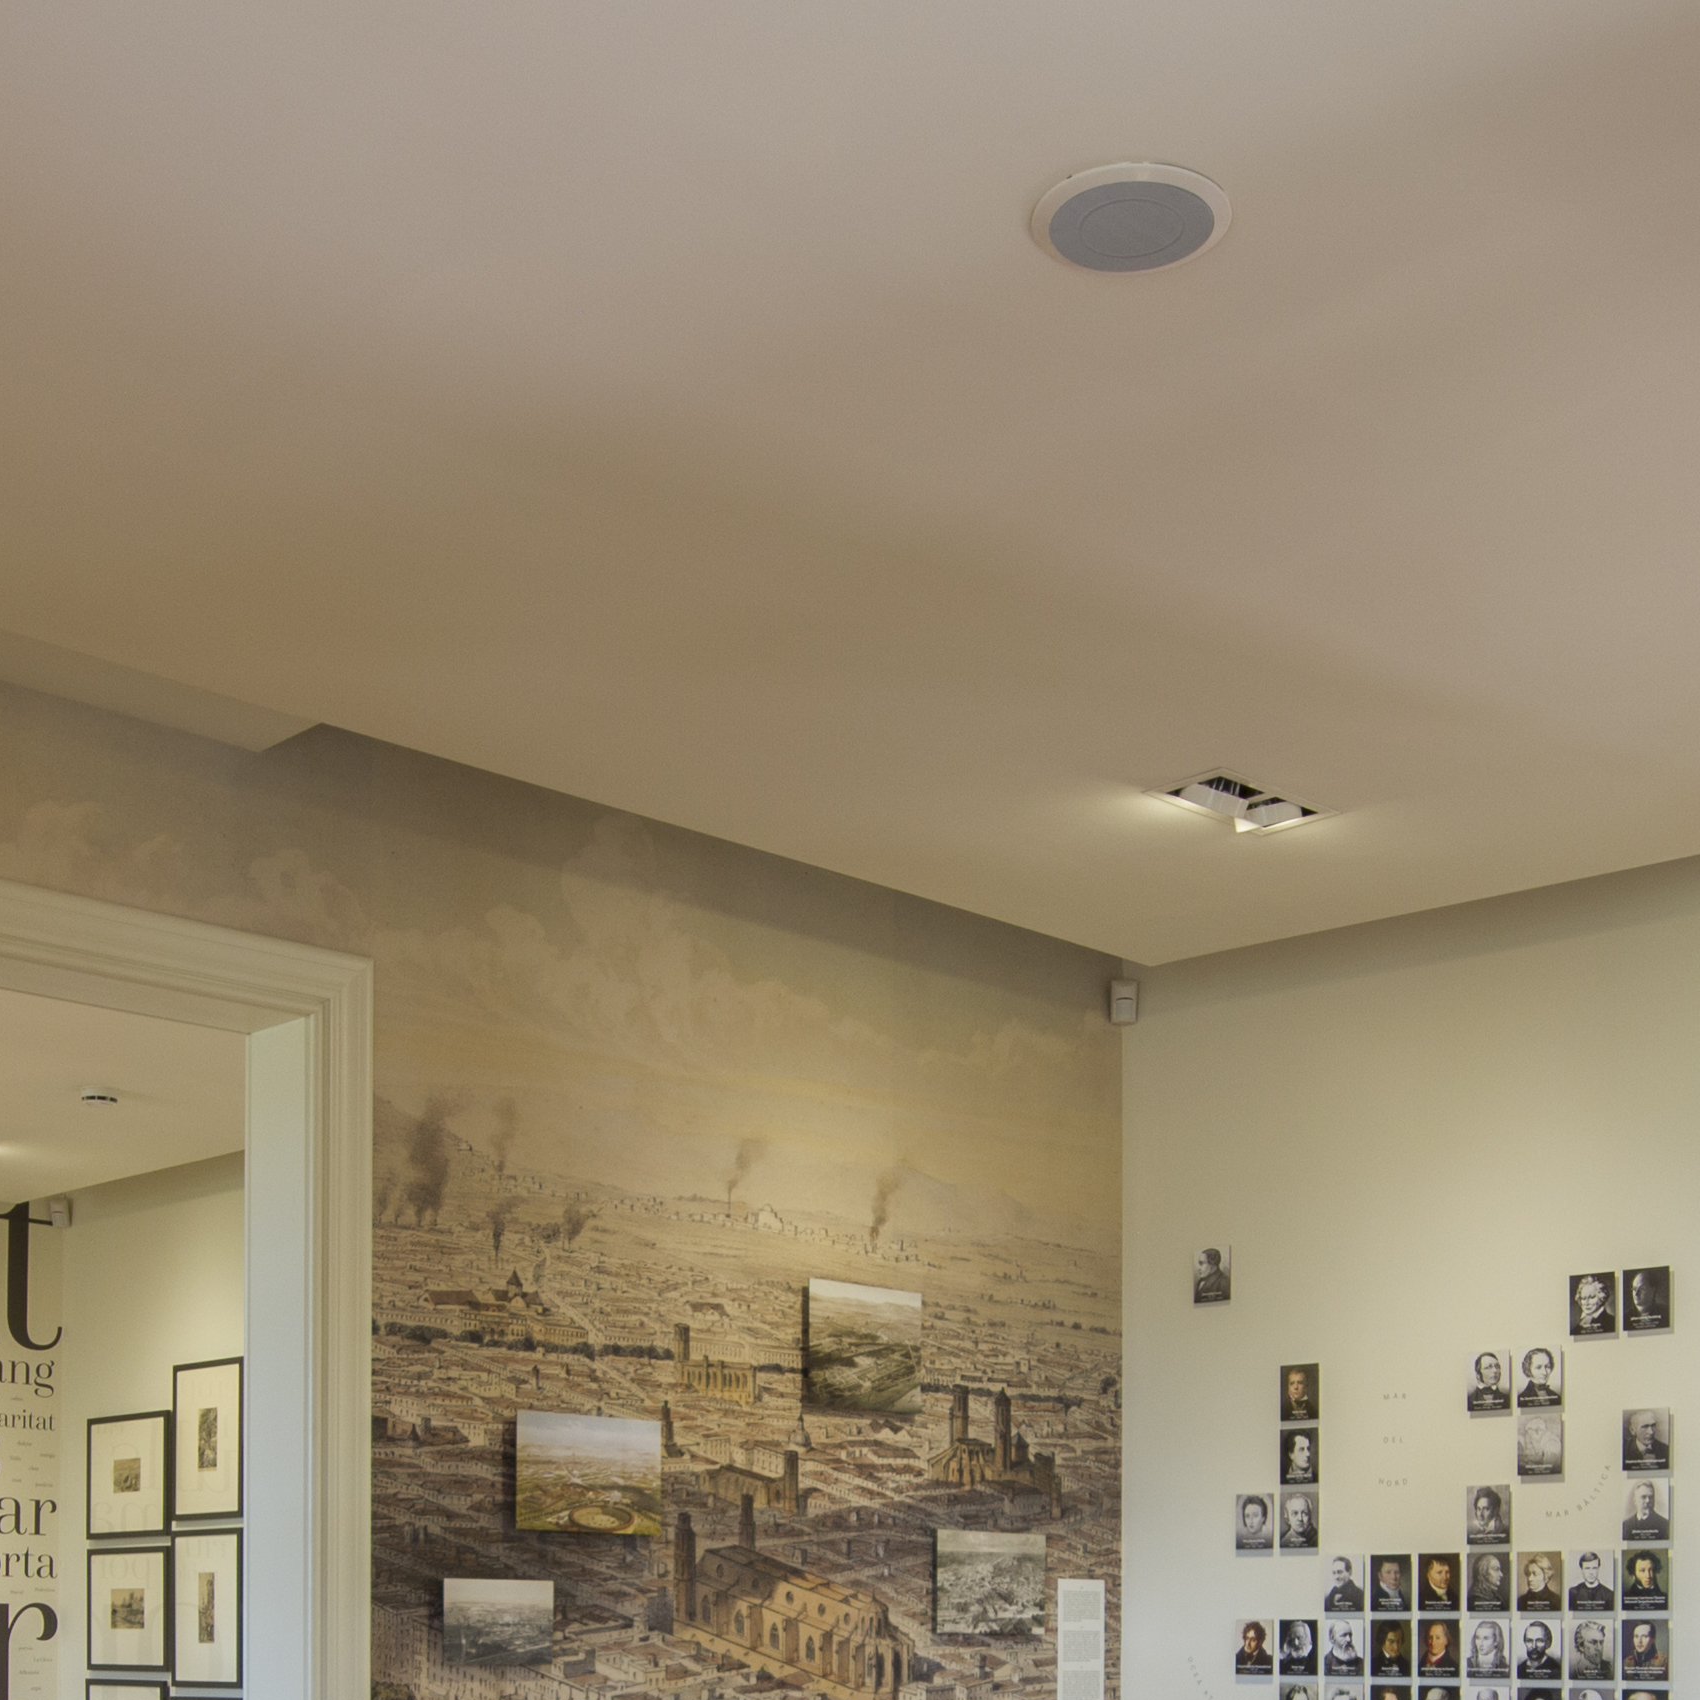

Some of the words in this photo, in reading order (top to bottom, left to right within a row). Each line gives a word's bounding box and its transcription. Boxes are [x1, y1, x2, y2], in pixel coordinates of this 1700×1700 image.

[1383, 1392, 1407, 1400] MAR
[1379, 1478, 1408, 1487] NORD
[1546, 1509, 1569, 1518] MAR
